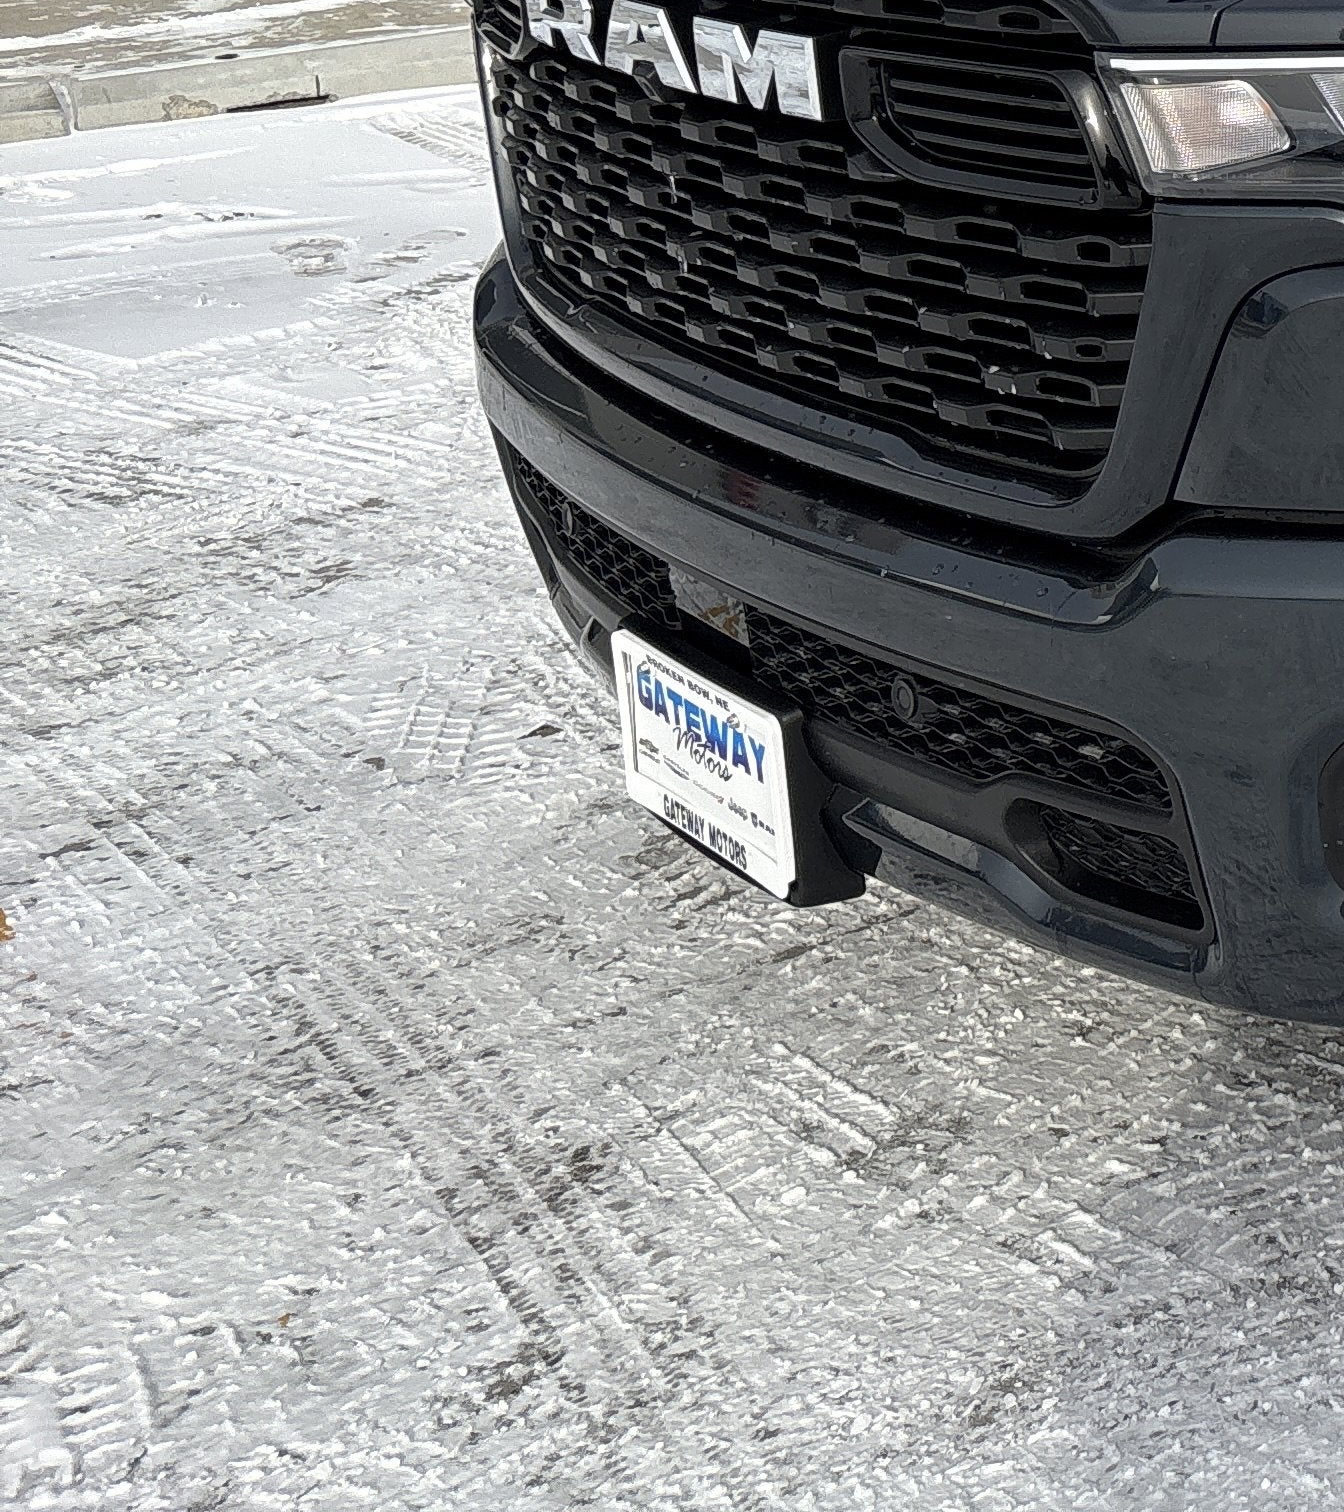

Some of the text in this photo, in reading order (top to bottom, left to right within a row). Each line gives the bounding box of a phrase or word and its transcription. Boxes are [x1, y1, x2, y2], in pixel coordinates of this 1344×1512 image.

[636, 663, 765, 784] GATEWAY
[672, 726, 733, 782] Motors
[663, 793, 748, 871] GATEWAY MOTORS
